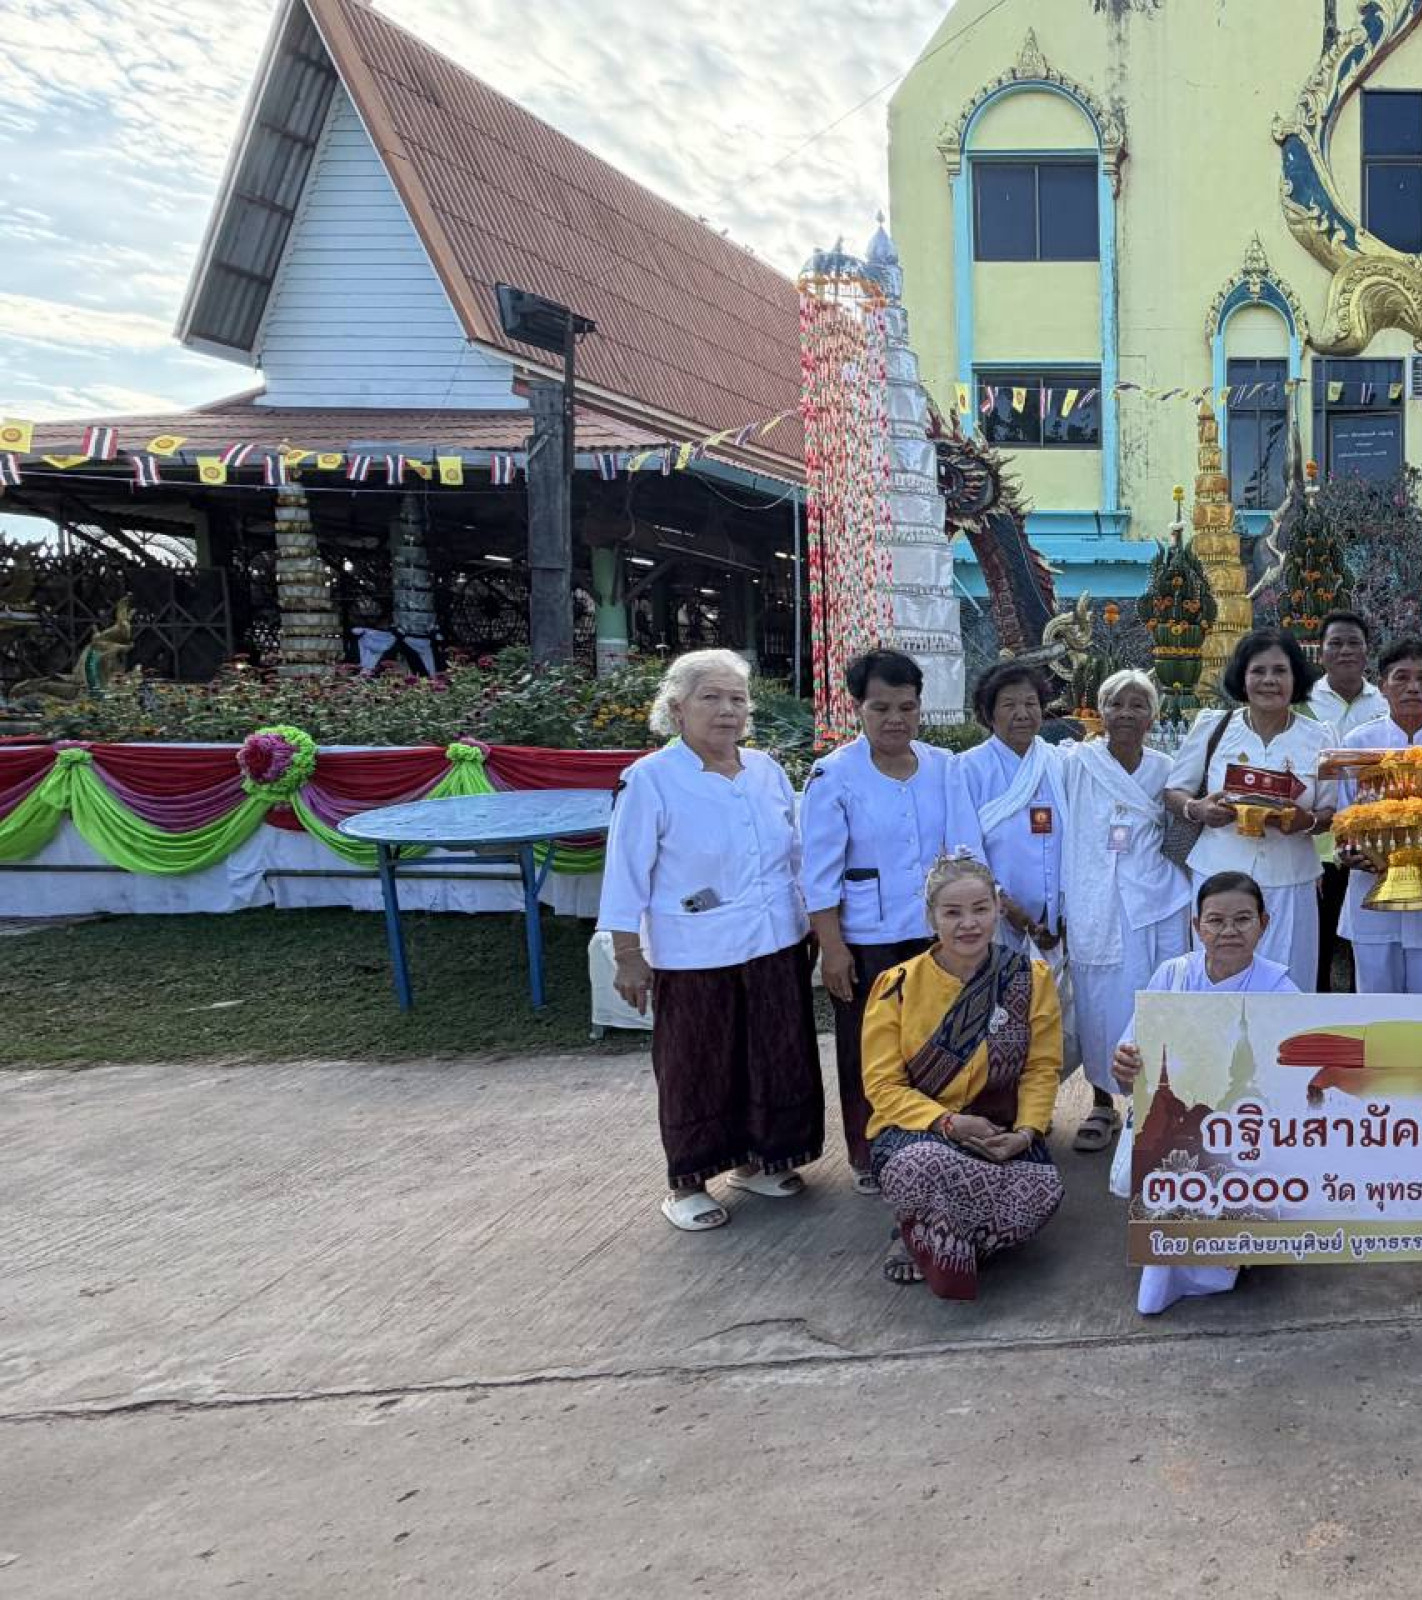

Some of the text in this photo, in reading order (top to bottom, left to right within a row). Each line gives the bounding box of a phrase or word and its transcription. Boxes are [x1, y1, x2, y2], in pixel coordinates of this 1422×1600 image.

[1148, 1177, 1310, 1209] ๓๐,๐๐๐
[1322, 1173, 1356, 1202] วัด
[1151, 1231, 1187, 1253] โดย
[1195, 1229, 1343, 1257] คณะศิษยานุศิษย์
